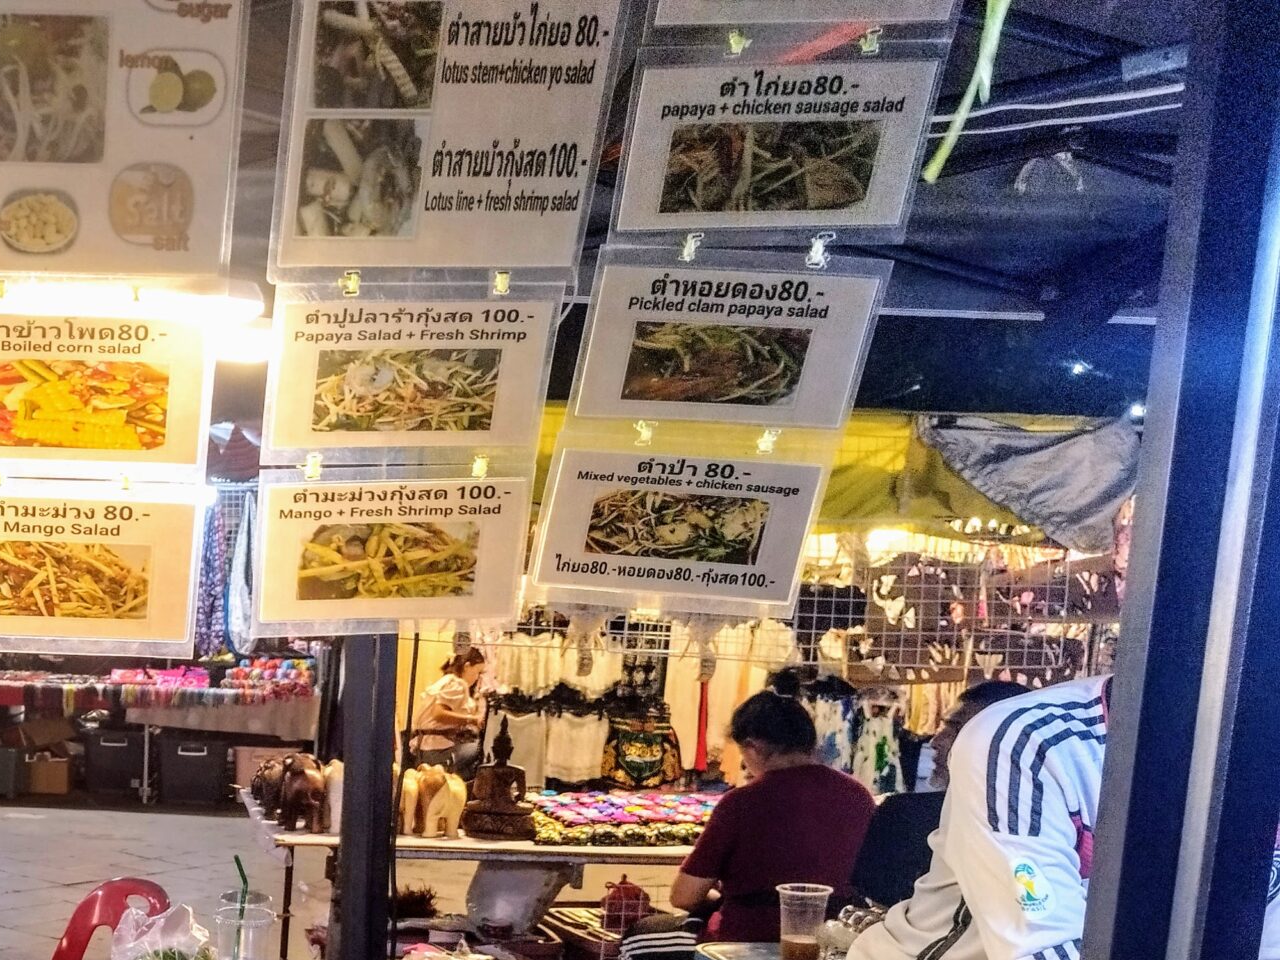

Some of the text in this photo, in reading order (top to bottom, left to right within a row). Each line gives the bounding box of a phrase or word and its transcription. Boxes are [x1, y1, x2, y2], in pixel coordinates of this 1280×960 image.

[177, 2, 232, 24] sugar
[575, 14, 610, 48] 80.-
[441, 57, 469, 85] lotus
[548, 65, 565, 91] yo
[565, 56, 596, 85] salad
[661, 97, 905, 120] papaya + chicken sausage salad
[424, 190, 580, 217] Lotus line + fresh shrimp salad
[481, 308, 535, 325] 100.-
[628, 296, 829, 320] Pickled clam papaya salad
[294, 328, 527, 344] Papaya Salad + Fresh Shrimp
[1, 340, 142, 355] Boiled corn salad
[704, 463, 752, 481] 80.-
[456, 485, 512, 500] 100.-
[577, 470, 800, 498] Mixed vegetables + chicken sausage
[104, 504, 151, 522] 80.-
[279, 503, 502, 521] Mango + Fresh Shrimp Salad
[3, 521, 121, 537] Mango Salad
